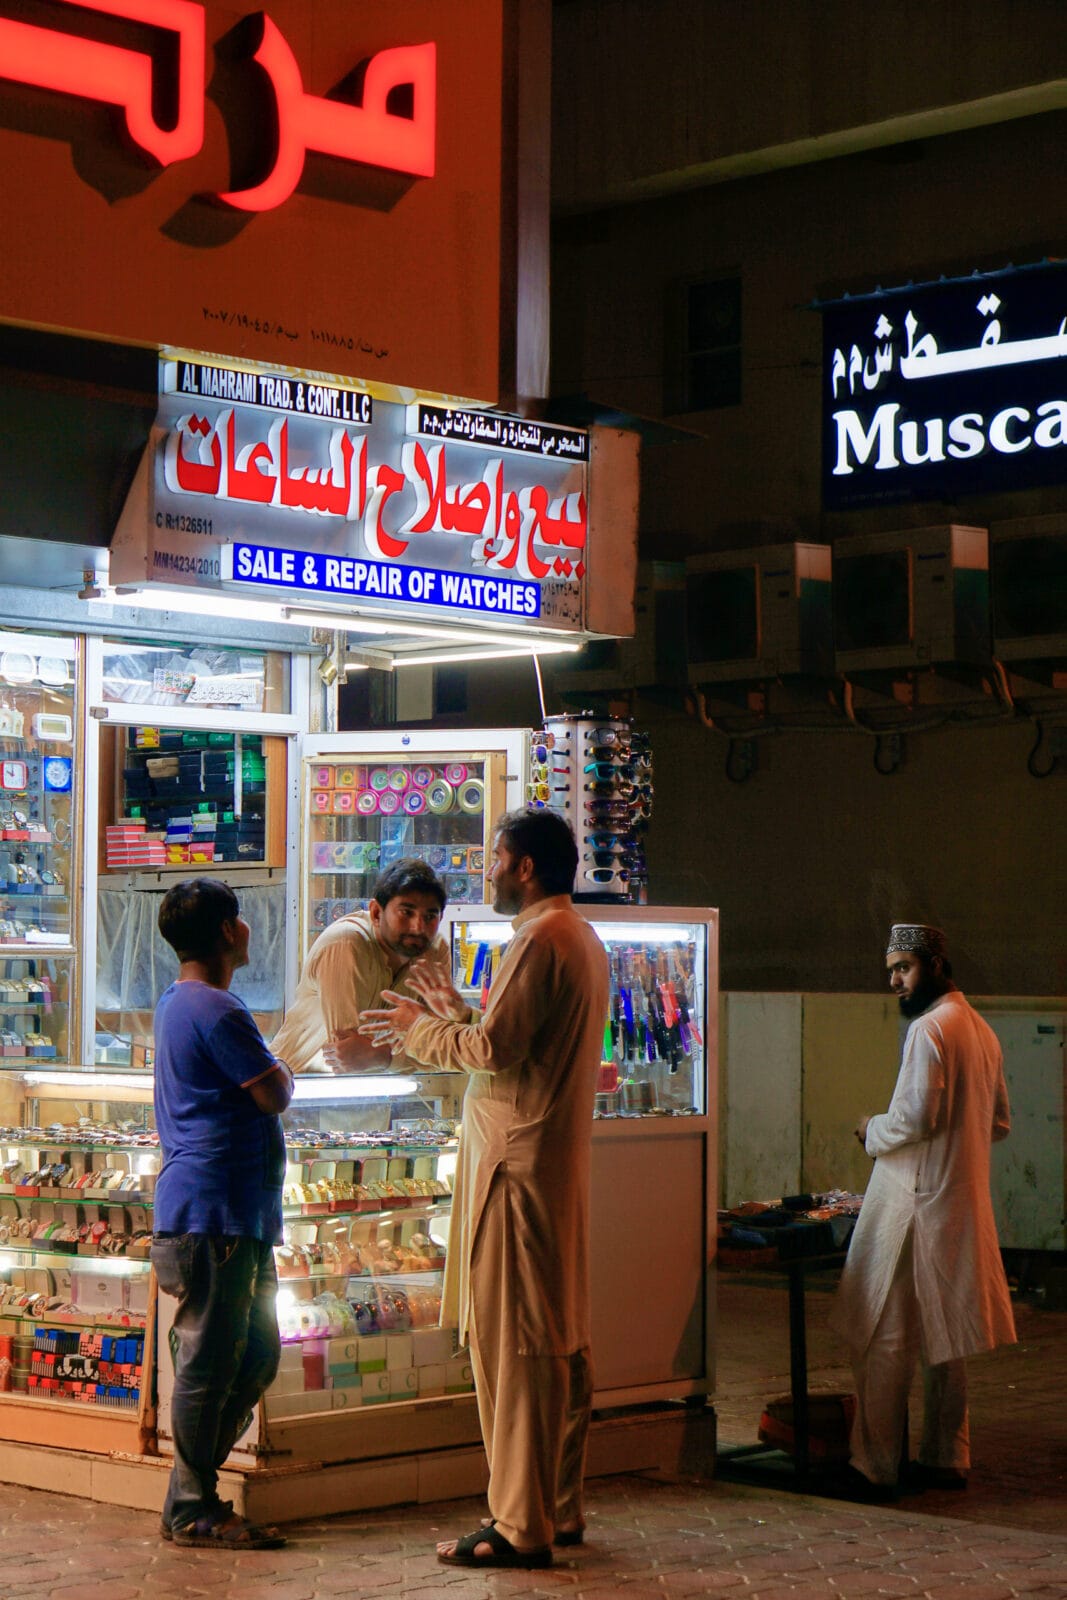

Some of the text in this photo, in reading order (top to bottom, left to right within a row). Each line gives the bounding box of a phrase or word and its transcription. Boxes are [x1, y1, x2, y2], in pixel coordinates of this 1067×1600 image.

[182, 363, 198, 392] AL
[201, 366, 256, 403] MAHRAMI
[259, 376, 292, 409] TRAD.
[296, 383, 304, 408] &
[307, 386, 340, 417] CONT.
[170, 407, 368, 521] الساعات
[520, 485, 587, 580] بيع
[237, 547, 537, 614] SALE & REPAIR OF WATCHES
